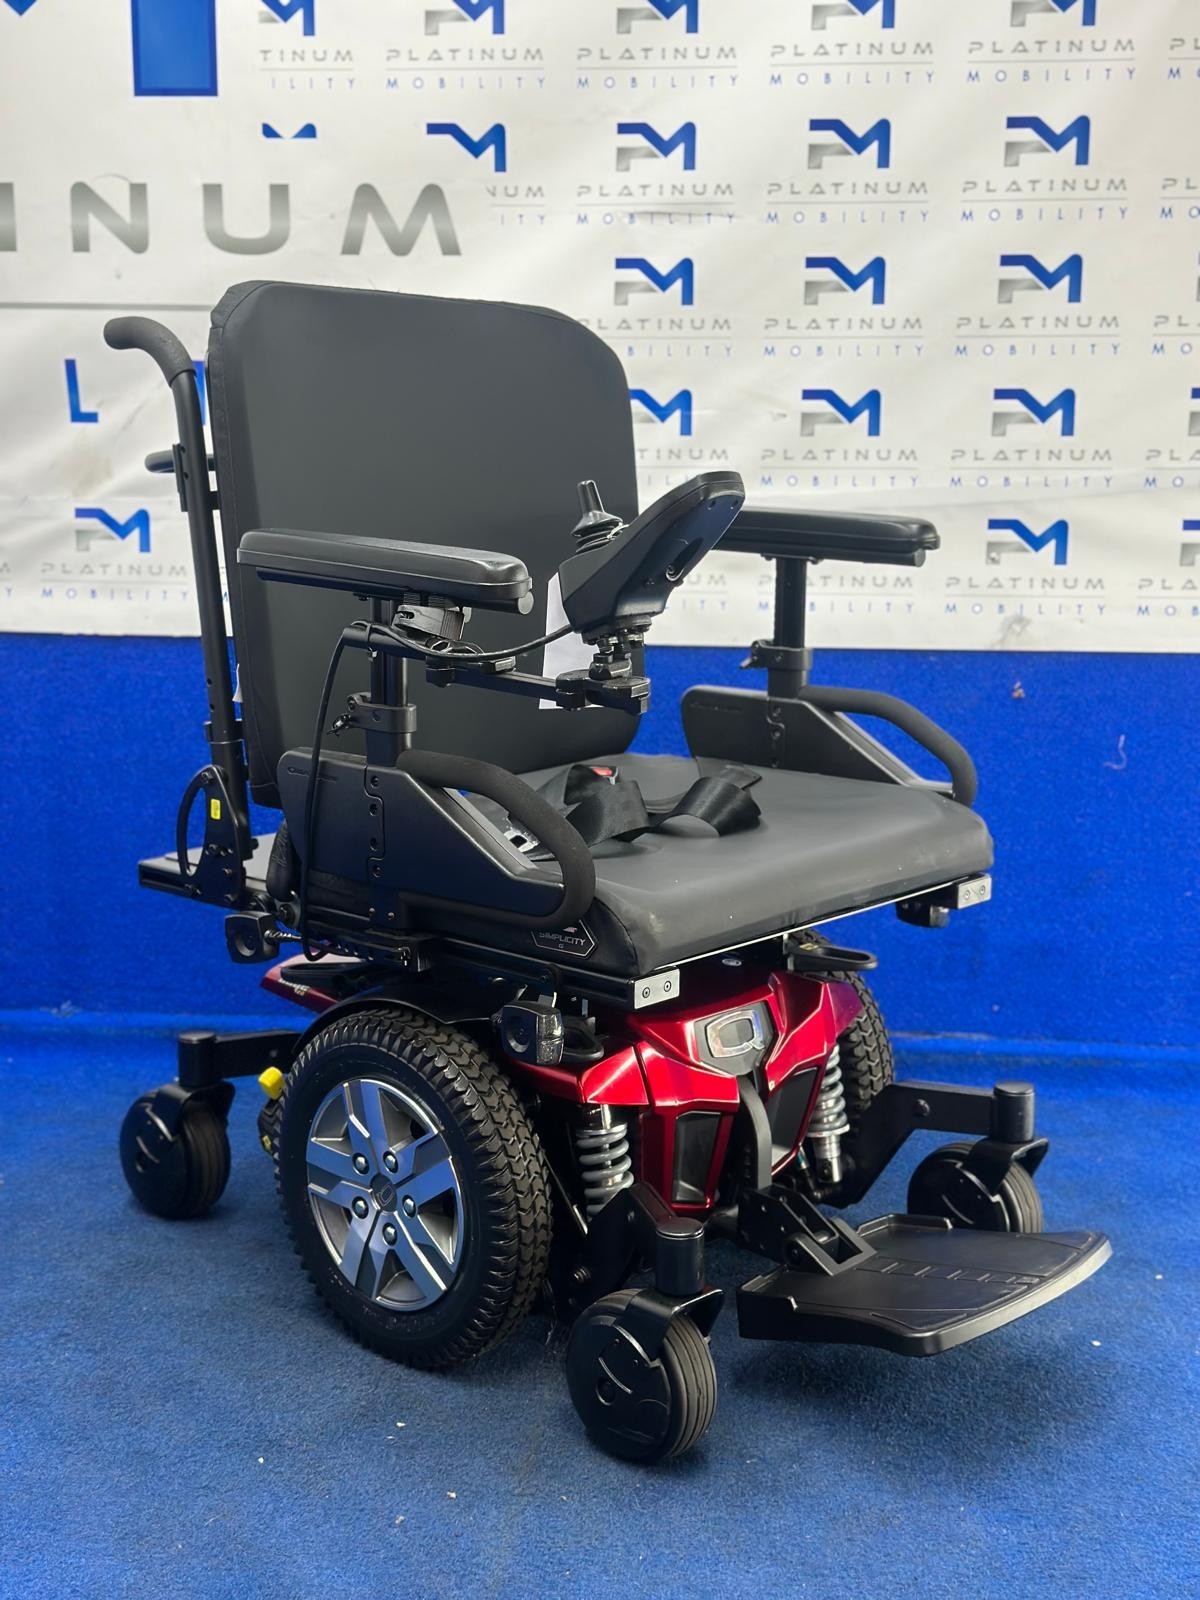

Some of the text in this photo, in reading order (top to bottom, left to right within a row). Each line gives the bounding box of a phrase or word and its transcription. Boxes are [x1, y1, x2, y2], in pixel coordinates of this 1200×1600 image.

[770, 42, 933, 57] PLATINUM
[967, 38, 1135, 54] PLATINUM
[386, 49, 543, 62] PLATINUM
[577, 47, 736, 61] PLATINUM
[770, 71, 934, 85] MOBILITY
[967, 67, 1136, 83] MOBILITY
[386, 77, 545, 89] MOBILITY
[577, 76, 738, 89] MOBILITY
[577, 184, 734, 197] PLATINUM
[767, 181, 928, 195] PLATINUM
[962, 178, 1127, 193] PLATINUM
[577, 213, 735, 225] MOBILITY
[767, 210, 929, 224] MOBILITY
[961, 207, 1129, 222] MOBILITY
[764, 317, 922, 331] PLATINUM
[956, 315, 1119, 330] PLATINUM
[628, 345, 732, 357] BILITY
[763, 345, 924, 357] MOBILITY
[955, 343, 1121, 357] MOBILITY
[638, 448, 728, 461] TINUM
[761, 449, 918, 462] PLATINUM
[950, 449, 1112, 462] PLATINUM
[760, 475, 920, 488] MOBILITY
[949, 475, 1114, 489] MOBILITY
[41, 563, 187, 576] PLATINUM
[758, 575, 913, 588] PATINUM
[946, 576, 1104, 591] PLATINUM
[41, 588, 188, 600] MOBILITY
[757, 601, 913, 614] MBILITY
[945, 602, 1106, 616] MOBILITY
